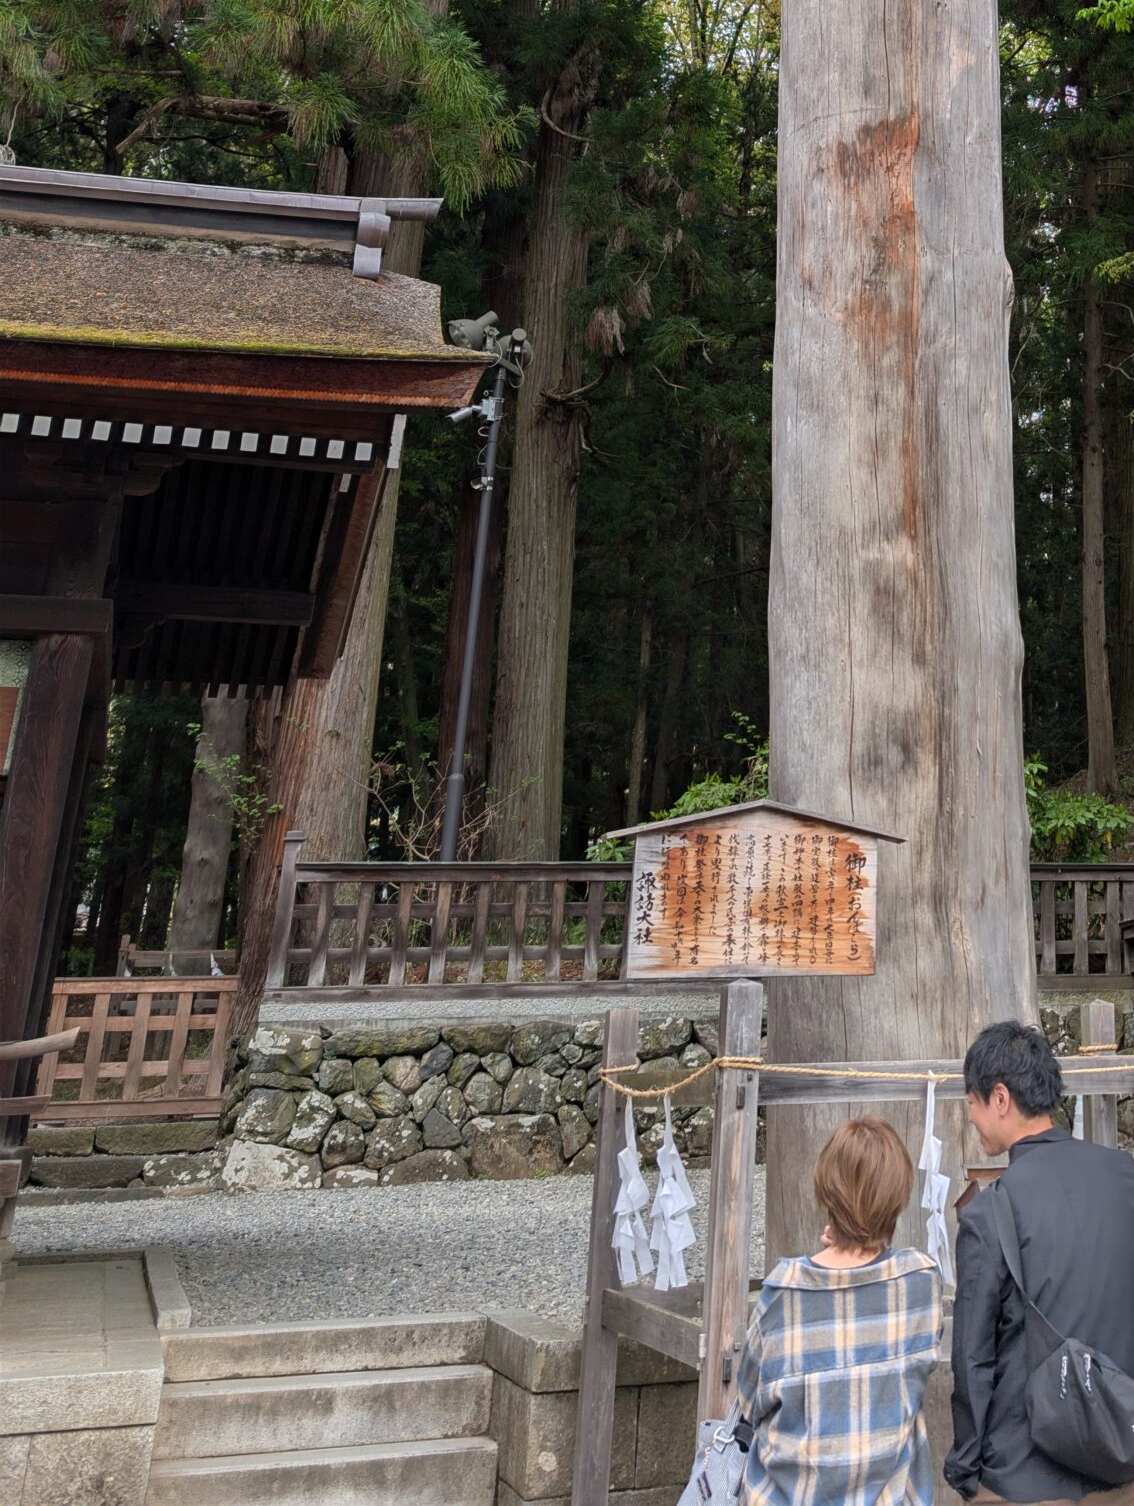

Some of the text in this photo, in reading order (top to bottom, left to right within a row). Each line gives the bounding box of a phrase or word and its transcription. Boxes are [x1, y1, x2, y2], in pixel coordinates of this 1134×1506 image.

[633, 871, 658, 945] 諏訪大社
[845, 853, 867, 961] 御柱(おんばしら)
